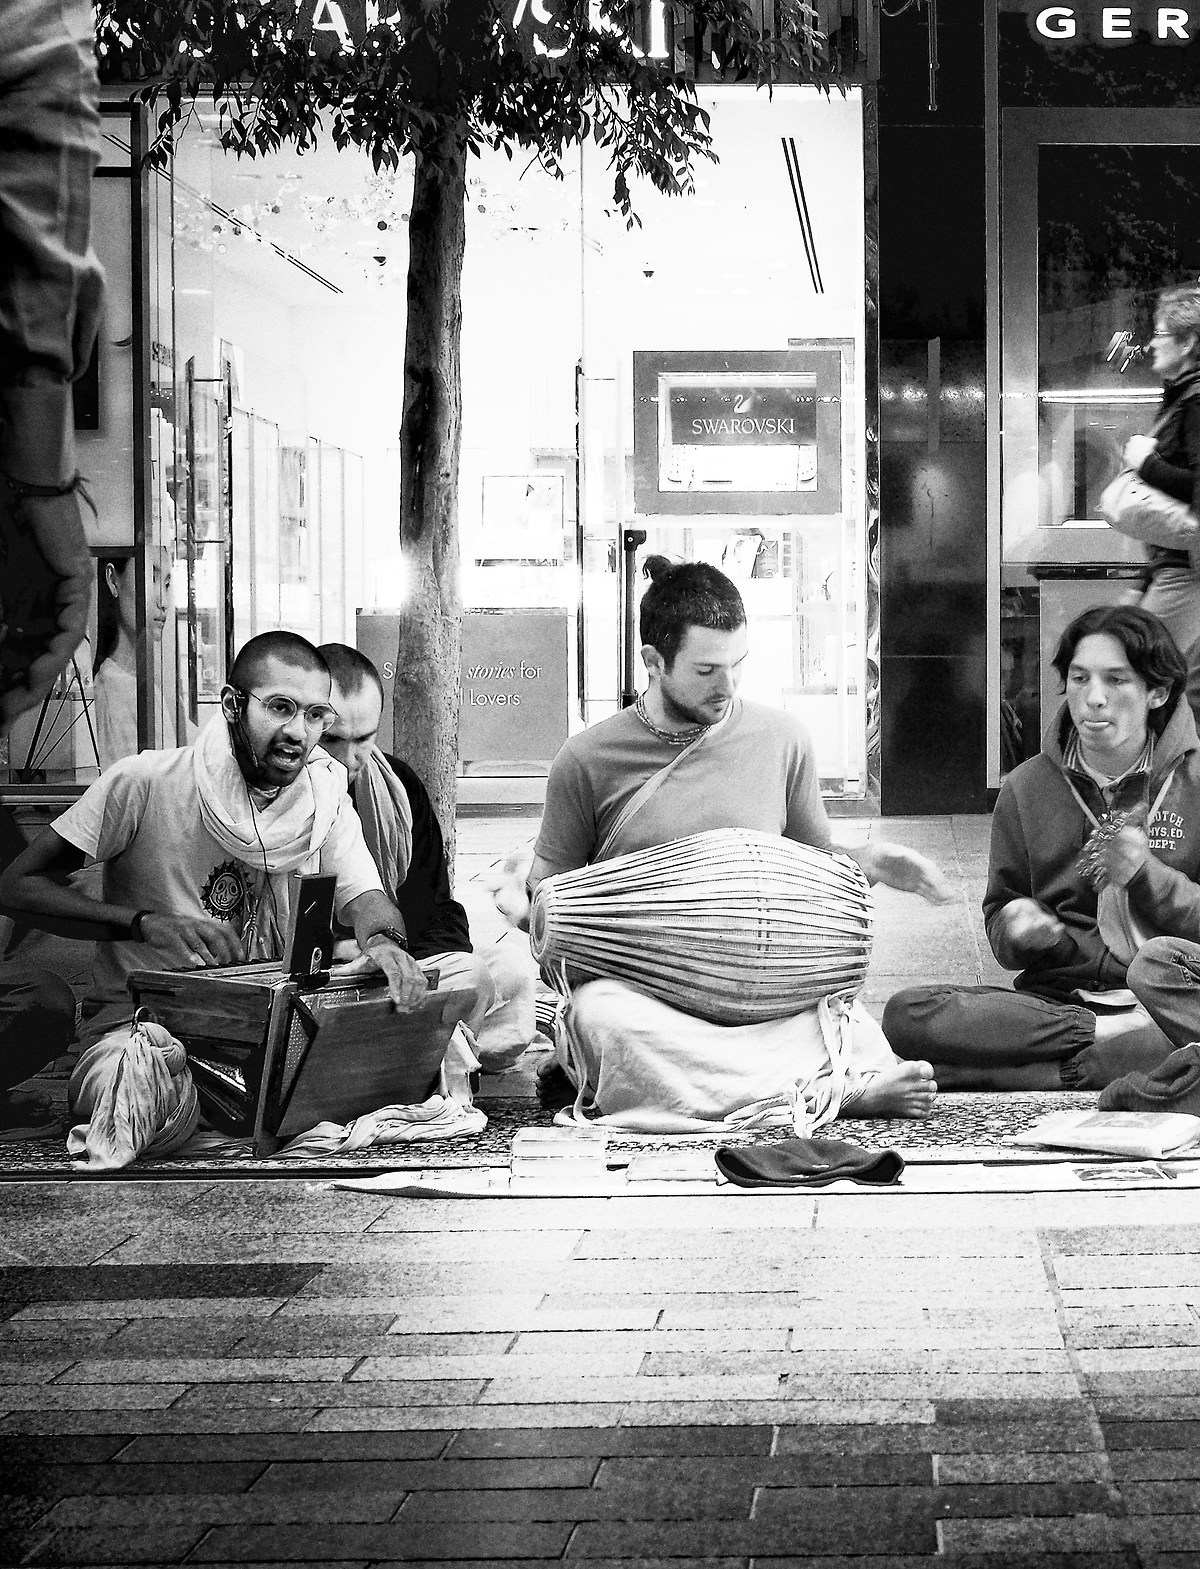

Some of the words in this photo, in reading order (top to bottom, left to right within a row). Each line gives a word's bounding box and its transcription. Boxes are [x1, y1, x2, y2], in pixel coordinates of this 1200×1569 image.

[692, 418, 796, 435] SWAROVSKI
[465, 662, 516, 679] stories
[519, 660, 542, 679] for
[470, 689, 521, 706] Lovers
[1149, 839, 1176, 850] DEPT.
